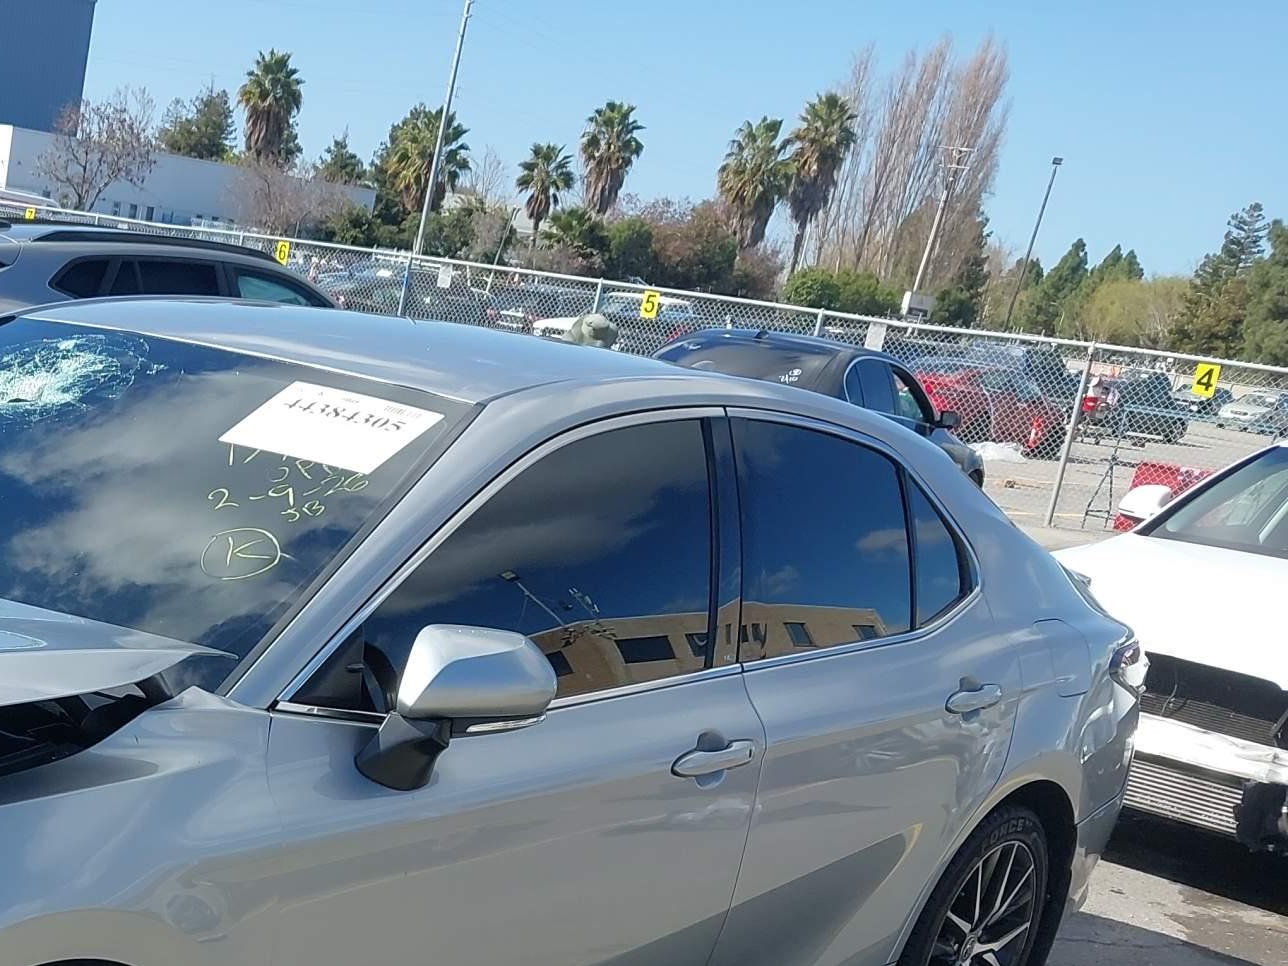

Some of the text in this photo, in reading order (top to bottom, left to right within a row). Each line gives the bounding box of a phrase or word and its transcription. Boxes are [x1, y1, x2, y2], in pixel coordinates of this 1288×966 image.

[278, 244, 287, 261] 6
[644, 294, 656, 313] 5
[1196, 368, 1215, 391] 4
[283, 399, 407, 432] 44384305
